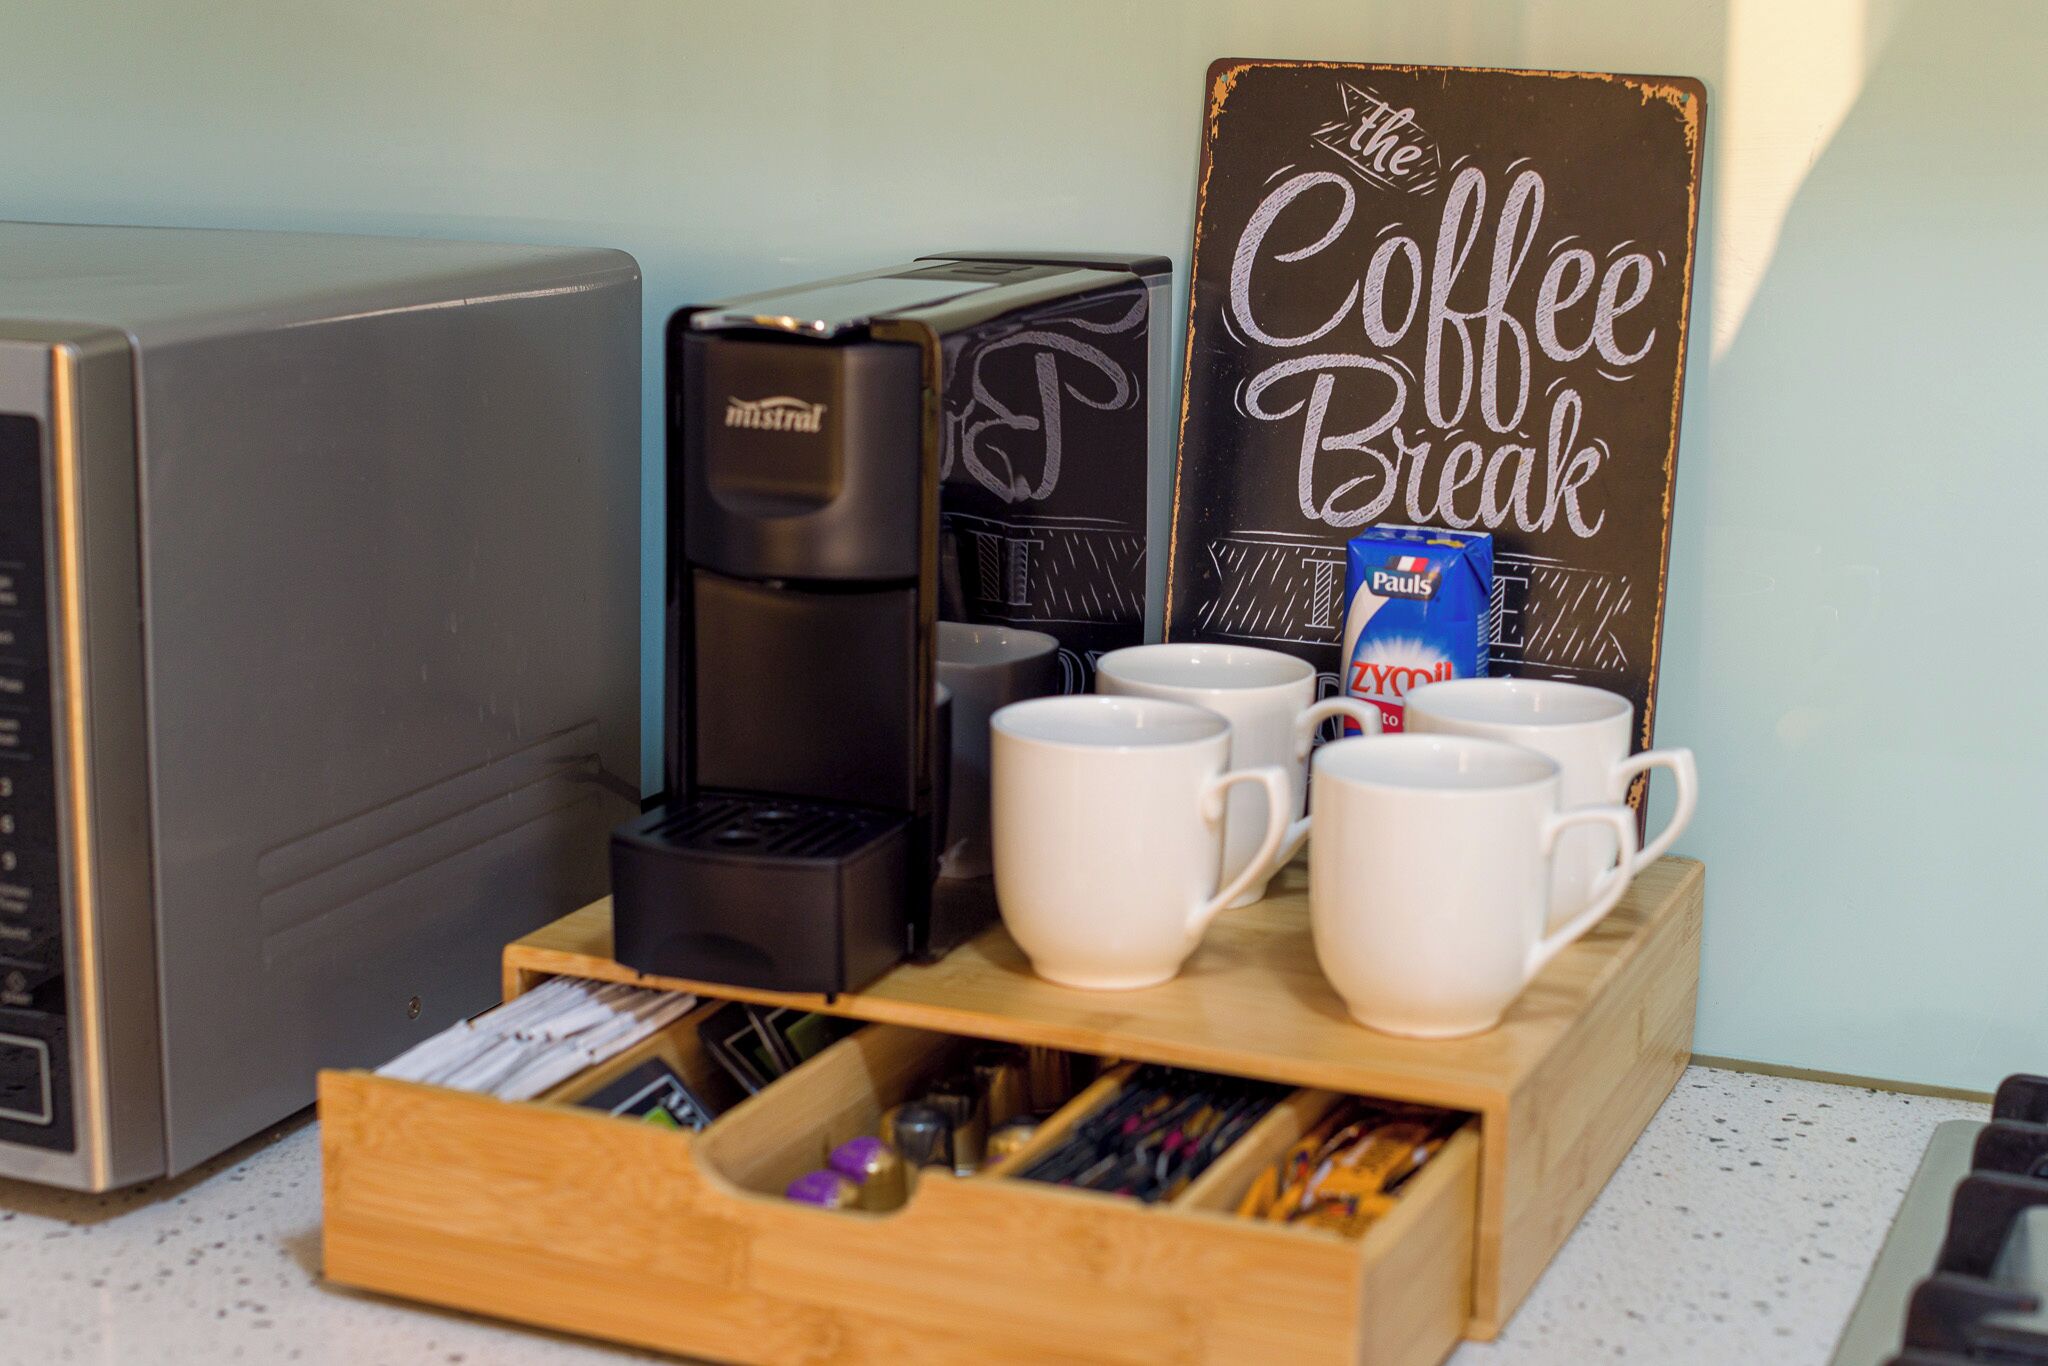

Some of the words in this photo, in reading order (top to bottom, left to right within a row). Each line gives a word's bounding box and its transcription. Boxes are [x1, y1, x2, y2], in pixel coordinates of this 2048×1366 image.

[1349, 102, 1422, 176] the
[1230, 166, 1656, 433] Coffee
[725, 402, 824, 433] mistral
[1245, 353, 1605, 538] Break
[1302, 558, 1528, 648] TE
[1372, 570, 1433, 596] Pauls
